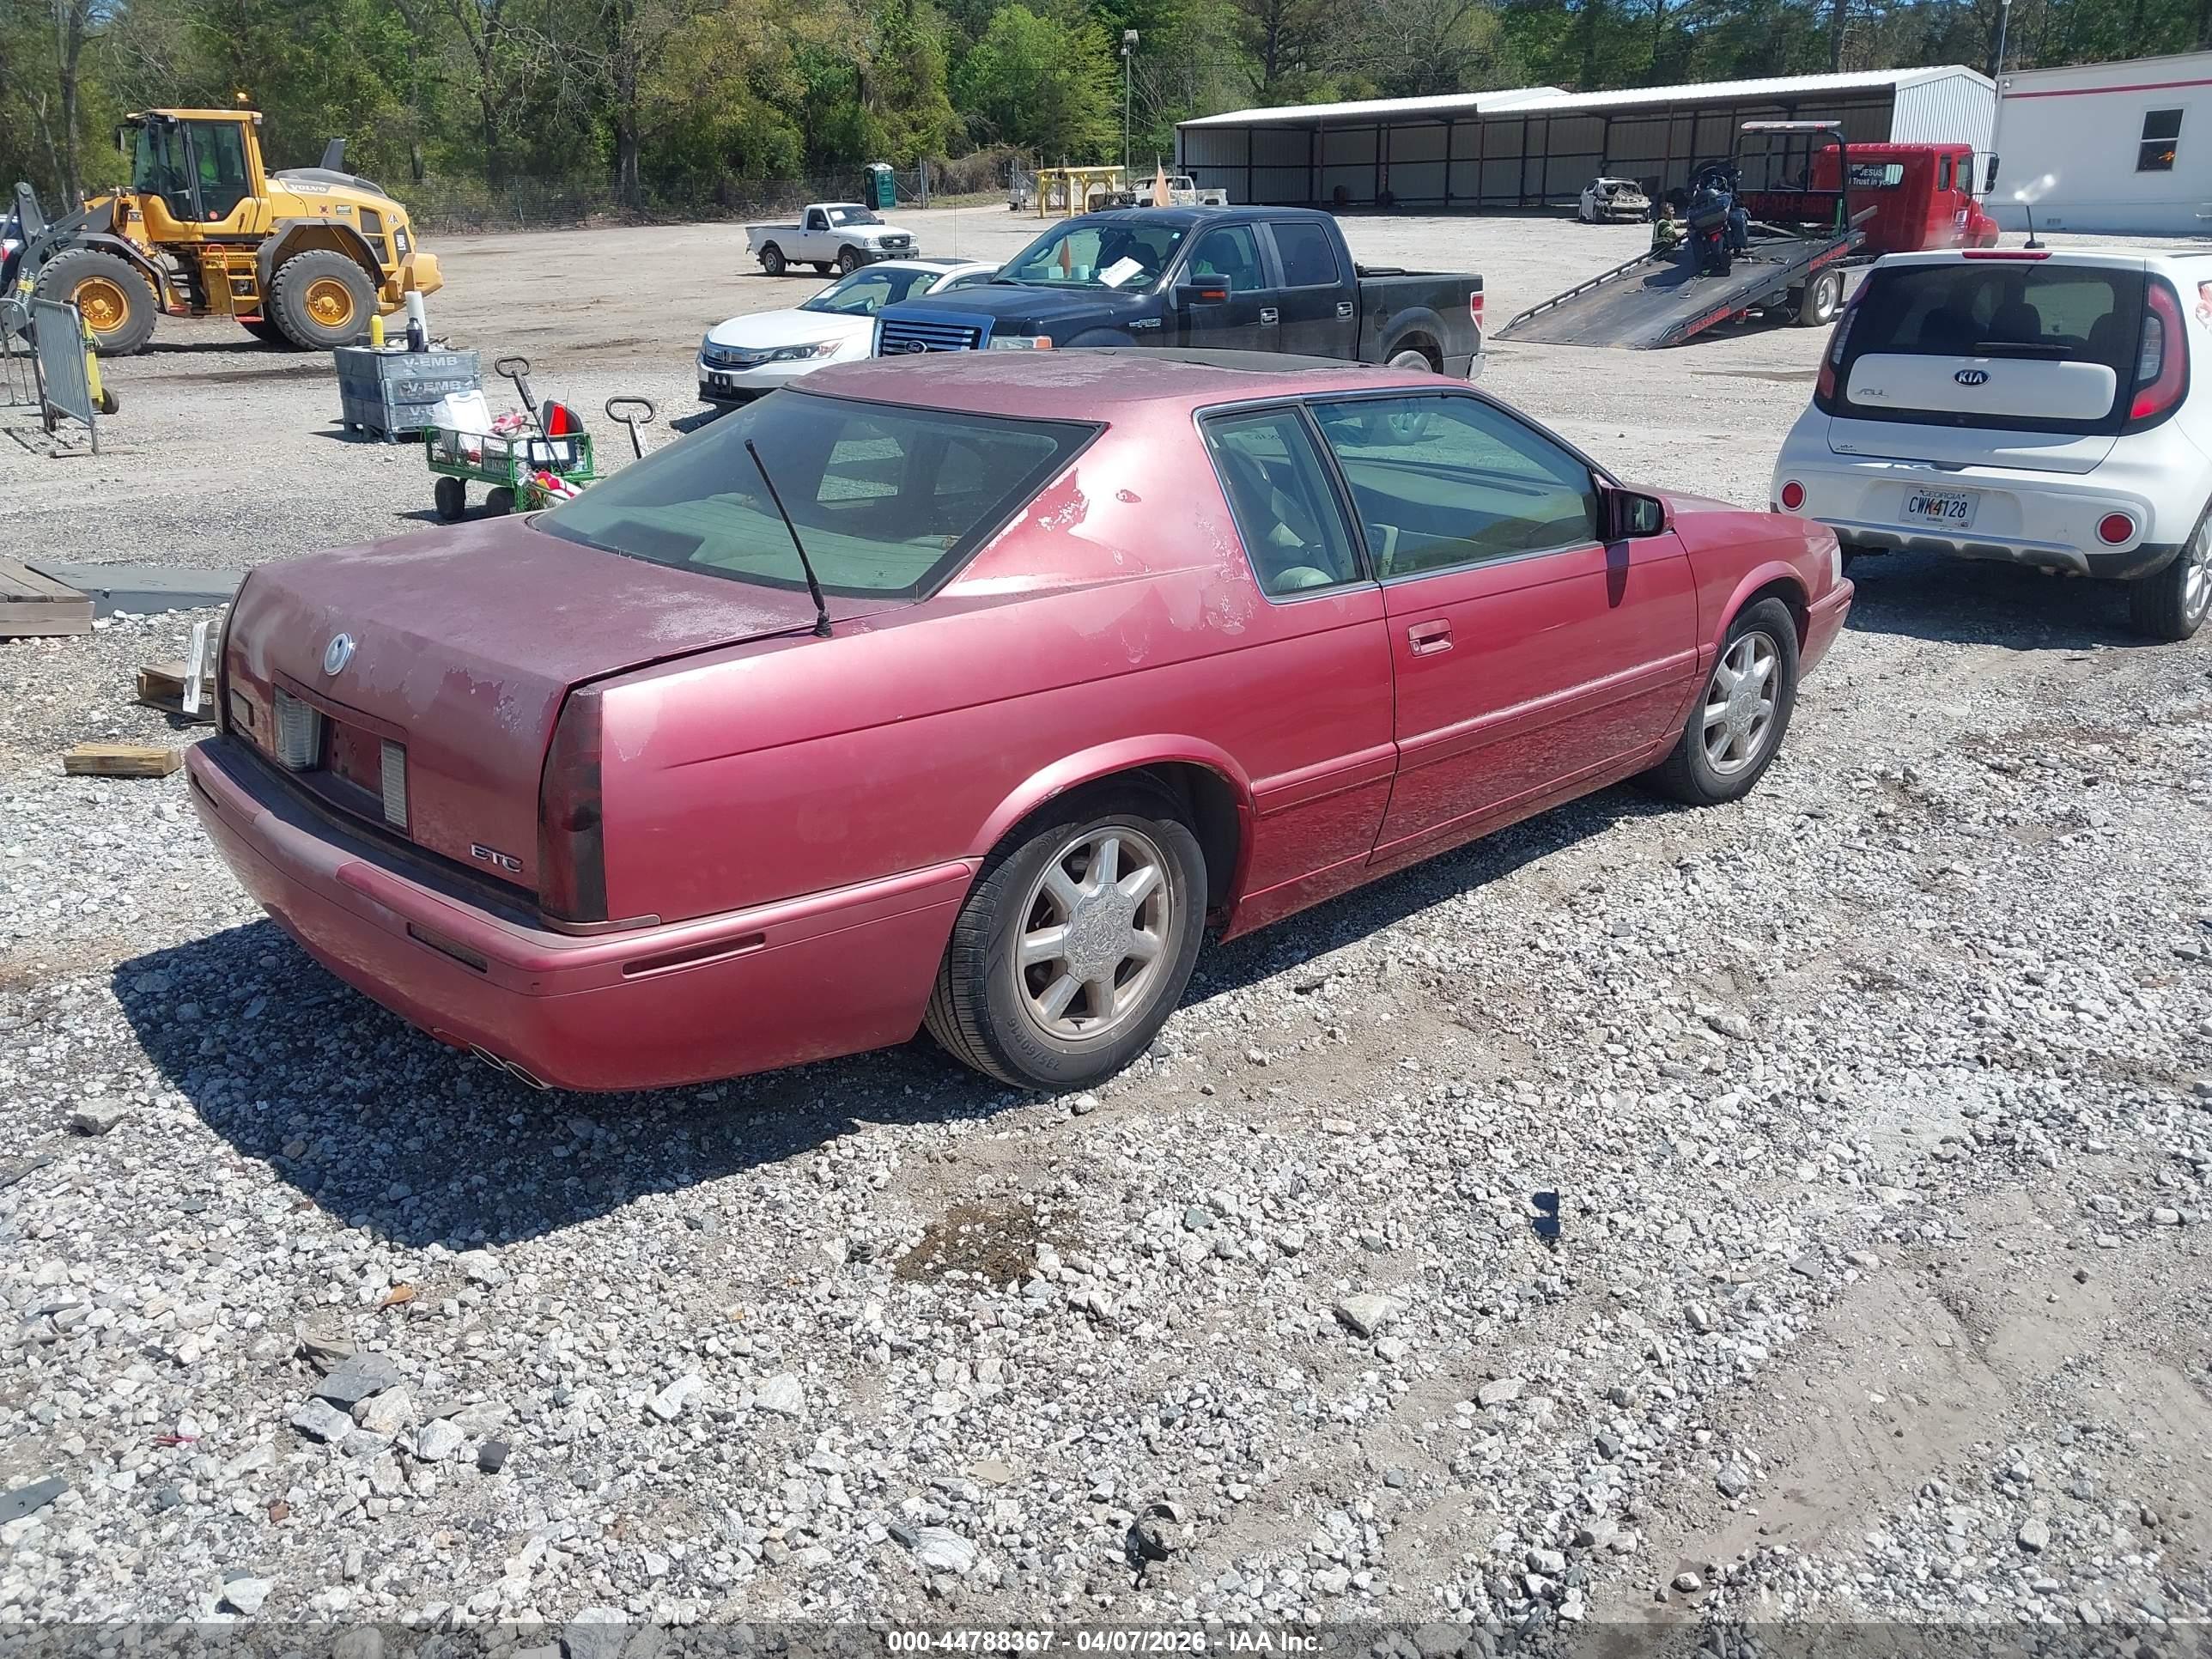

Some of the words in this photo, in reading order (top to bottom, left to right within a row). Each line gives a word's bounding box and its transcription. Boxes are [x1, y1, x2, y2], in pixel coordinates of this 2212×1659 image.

[290, 184, 326, 192] VOLVO
[403, 356, 458, 367] V-EMB
[1958, 372, 1984, 383] KIA
[409, 380, 461, 392] V-EMB
[1922, 490, 1961, 500] GEORGIA
[1909, 496, 1967, 518] CWK4128
[471, 843, 523, 873] ETC
